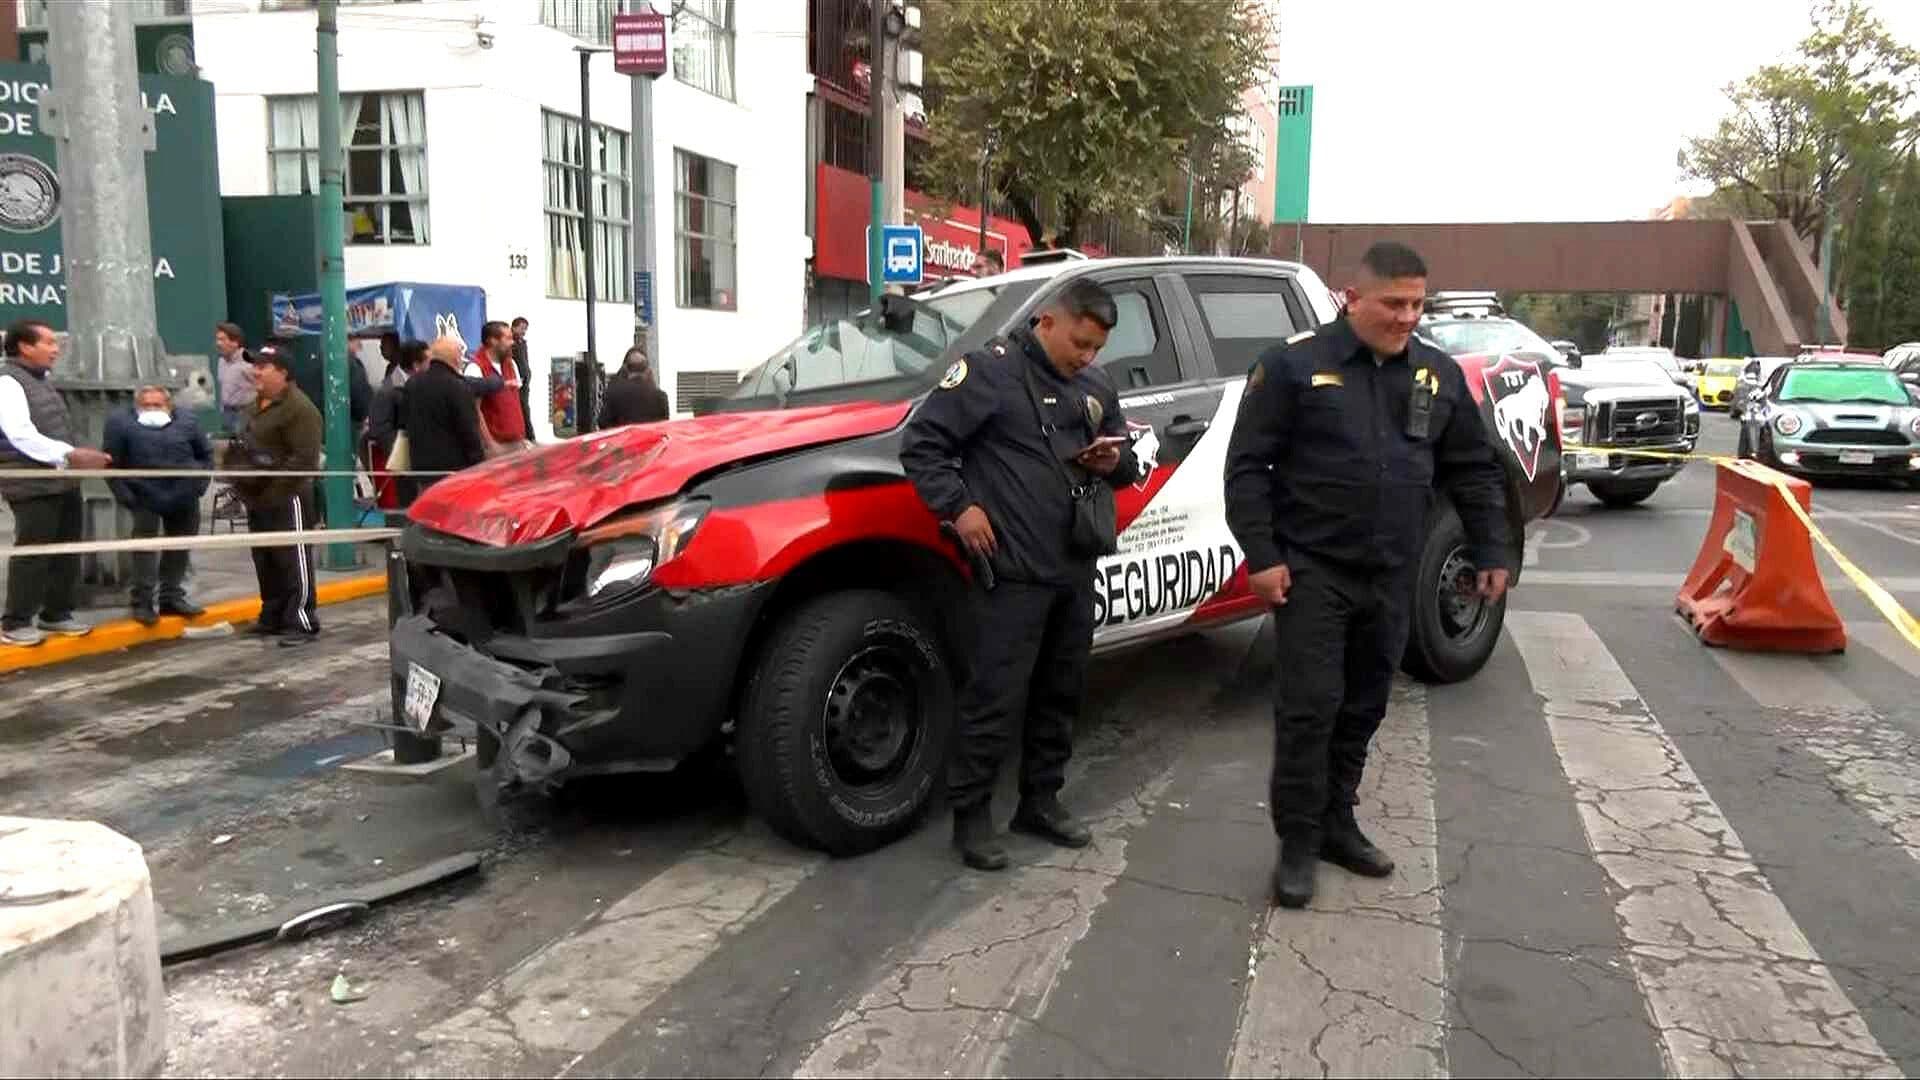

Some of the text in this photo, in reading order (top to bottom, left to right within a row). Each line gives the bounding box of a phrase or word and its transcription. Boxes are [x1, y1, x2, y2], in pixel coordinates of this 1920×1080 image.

[1, 252, 43, 275] DE
[508, 253, 528, 271] 133
[0, 283, 67, 305] RNA
[1093, 544, 1236, 626] SEGURIDAD
